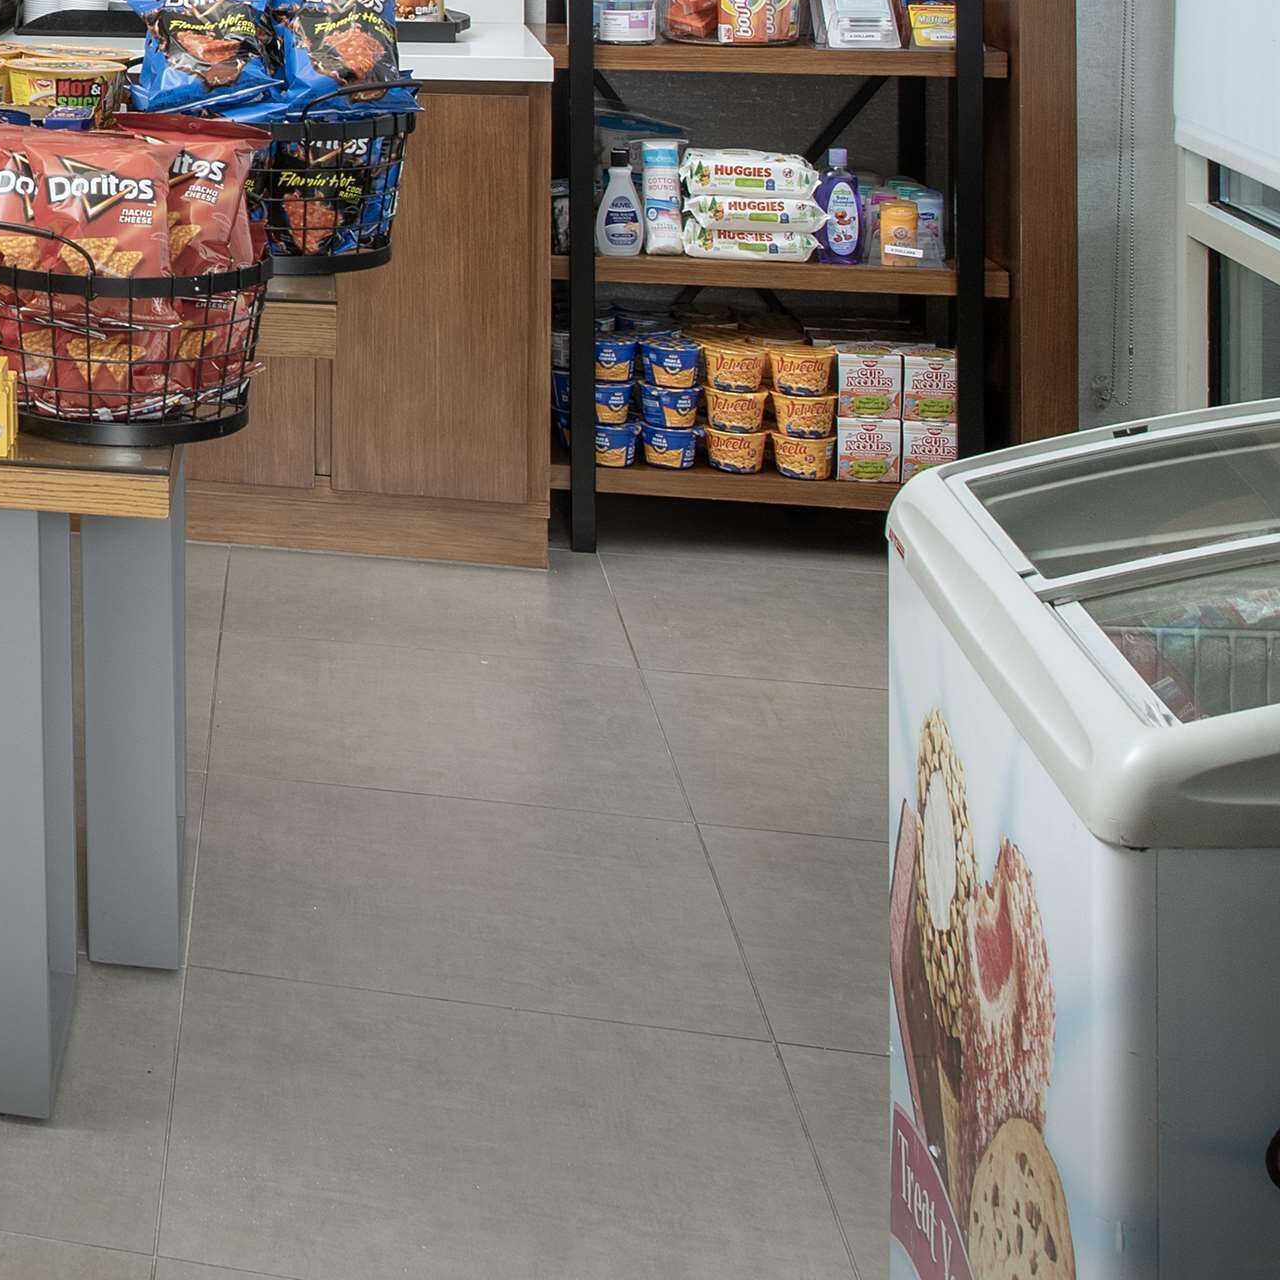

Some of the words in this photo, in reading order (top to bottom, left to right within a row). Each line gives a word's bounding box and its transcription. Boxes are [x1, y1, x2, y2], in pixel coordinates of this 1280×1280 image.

[57, 79, 91, 96] HOT
[91, 83, 102, 95] &
[714, 164, 772, 178] HUGGIES
[47, 174, 155, 203] Doritos
[188, 184, 219, 197] NACHO
[184, 190, 217, 204] CHEESE
[728, 200, 785, 212] HUGGIES
[121, 208, 153, 217] NACHO
[119, 215, 153, 225] CHEESE
[715, 354, 762, 372] Velveeta
[777, 356, 824, 373] Velveeta
[857, 368, 885, 378] CUP
[923, 371, 950, 382] CUP
[846, 376, 894, 388] NOODLES
[911, 379, 958, 391] NOODLES
[711, 396, 757, 412] Velveeta
[786, 400, 832, 418] Velveeta
[856, 432, 883, 442] CUP
[922, 436, 949, 447] CUP
[845, 440, 892, 452] NOODLES
[910, 444, 957, 456] NOODLES
[897, 1128, 938, 1264] Treat
